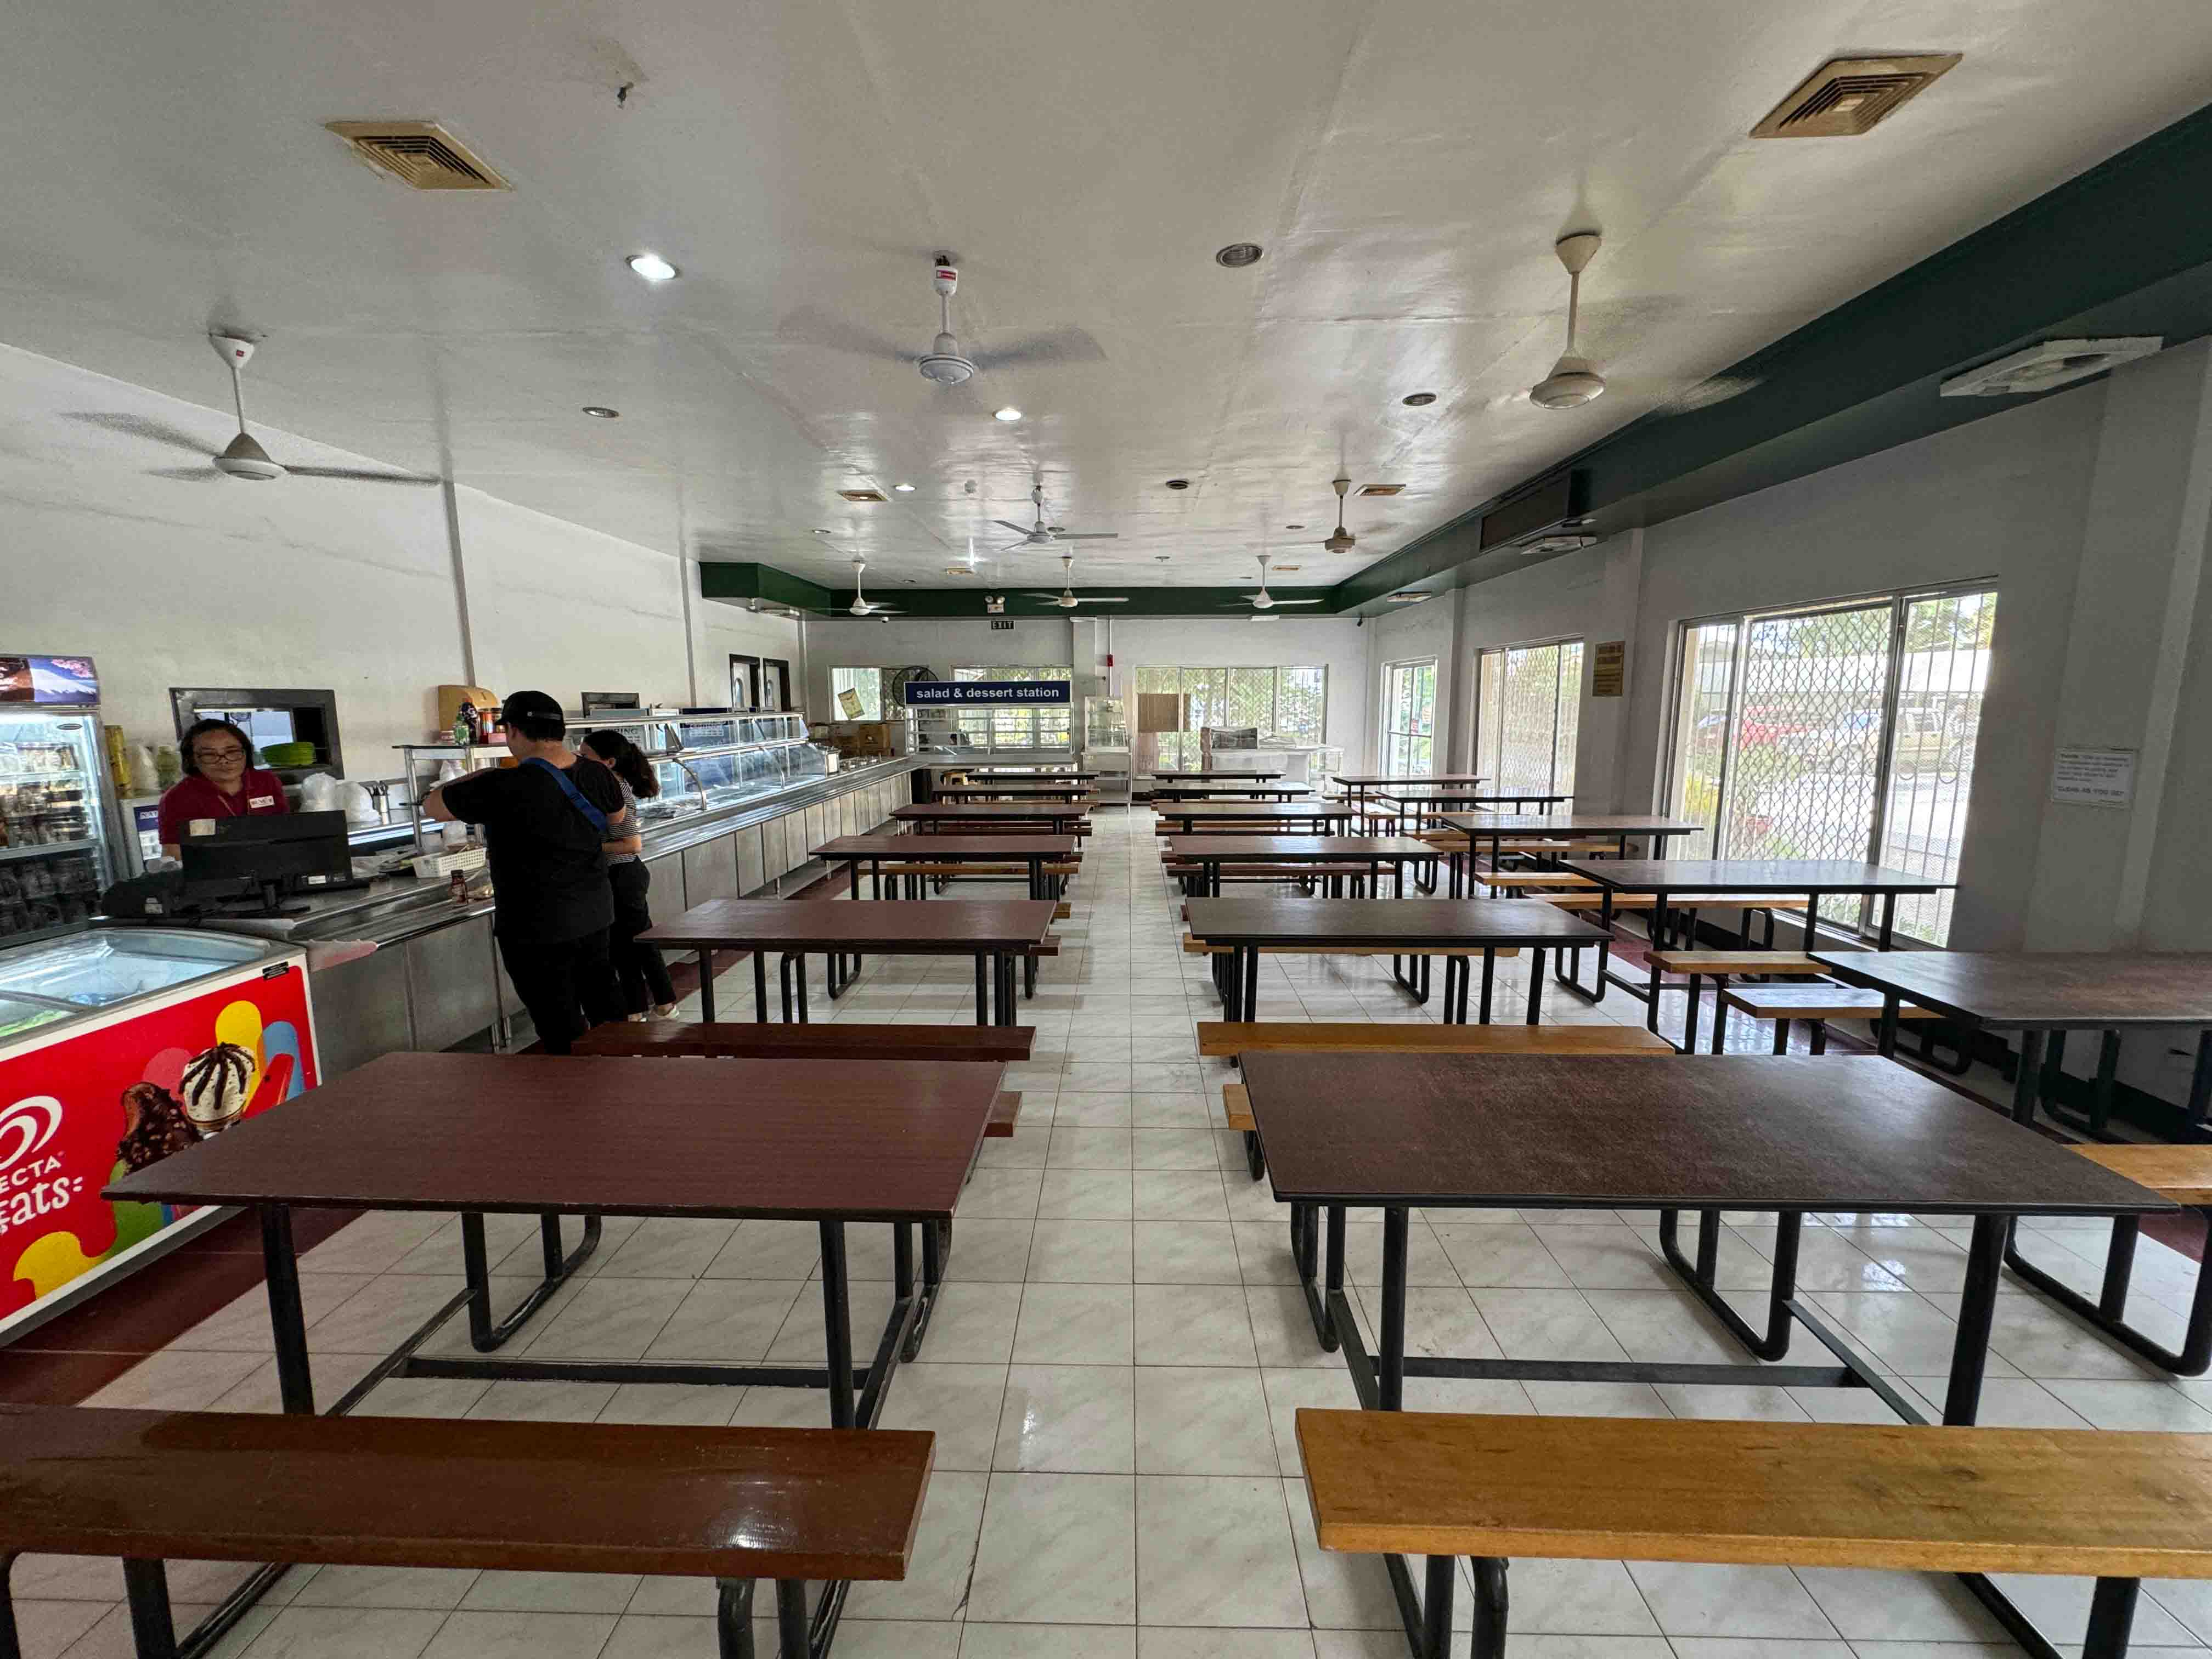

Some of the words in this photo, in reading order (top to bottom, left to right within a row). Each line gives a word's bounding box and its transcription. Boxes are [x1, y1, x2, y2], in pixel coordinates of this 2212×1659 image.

[917, 688, 950, 698] salad
[953, 687, 963, 698] &
[966, 687, 1013, 698] dessert
[1016, 687, 1059, 697] station
